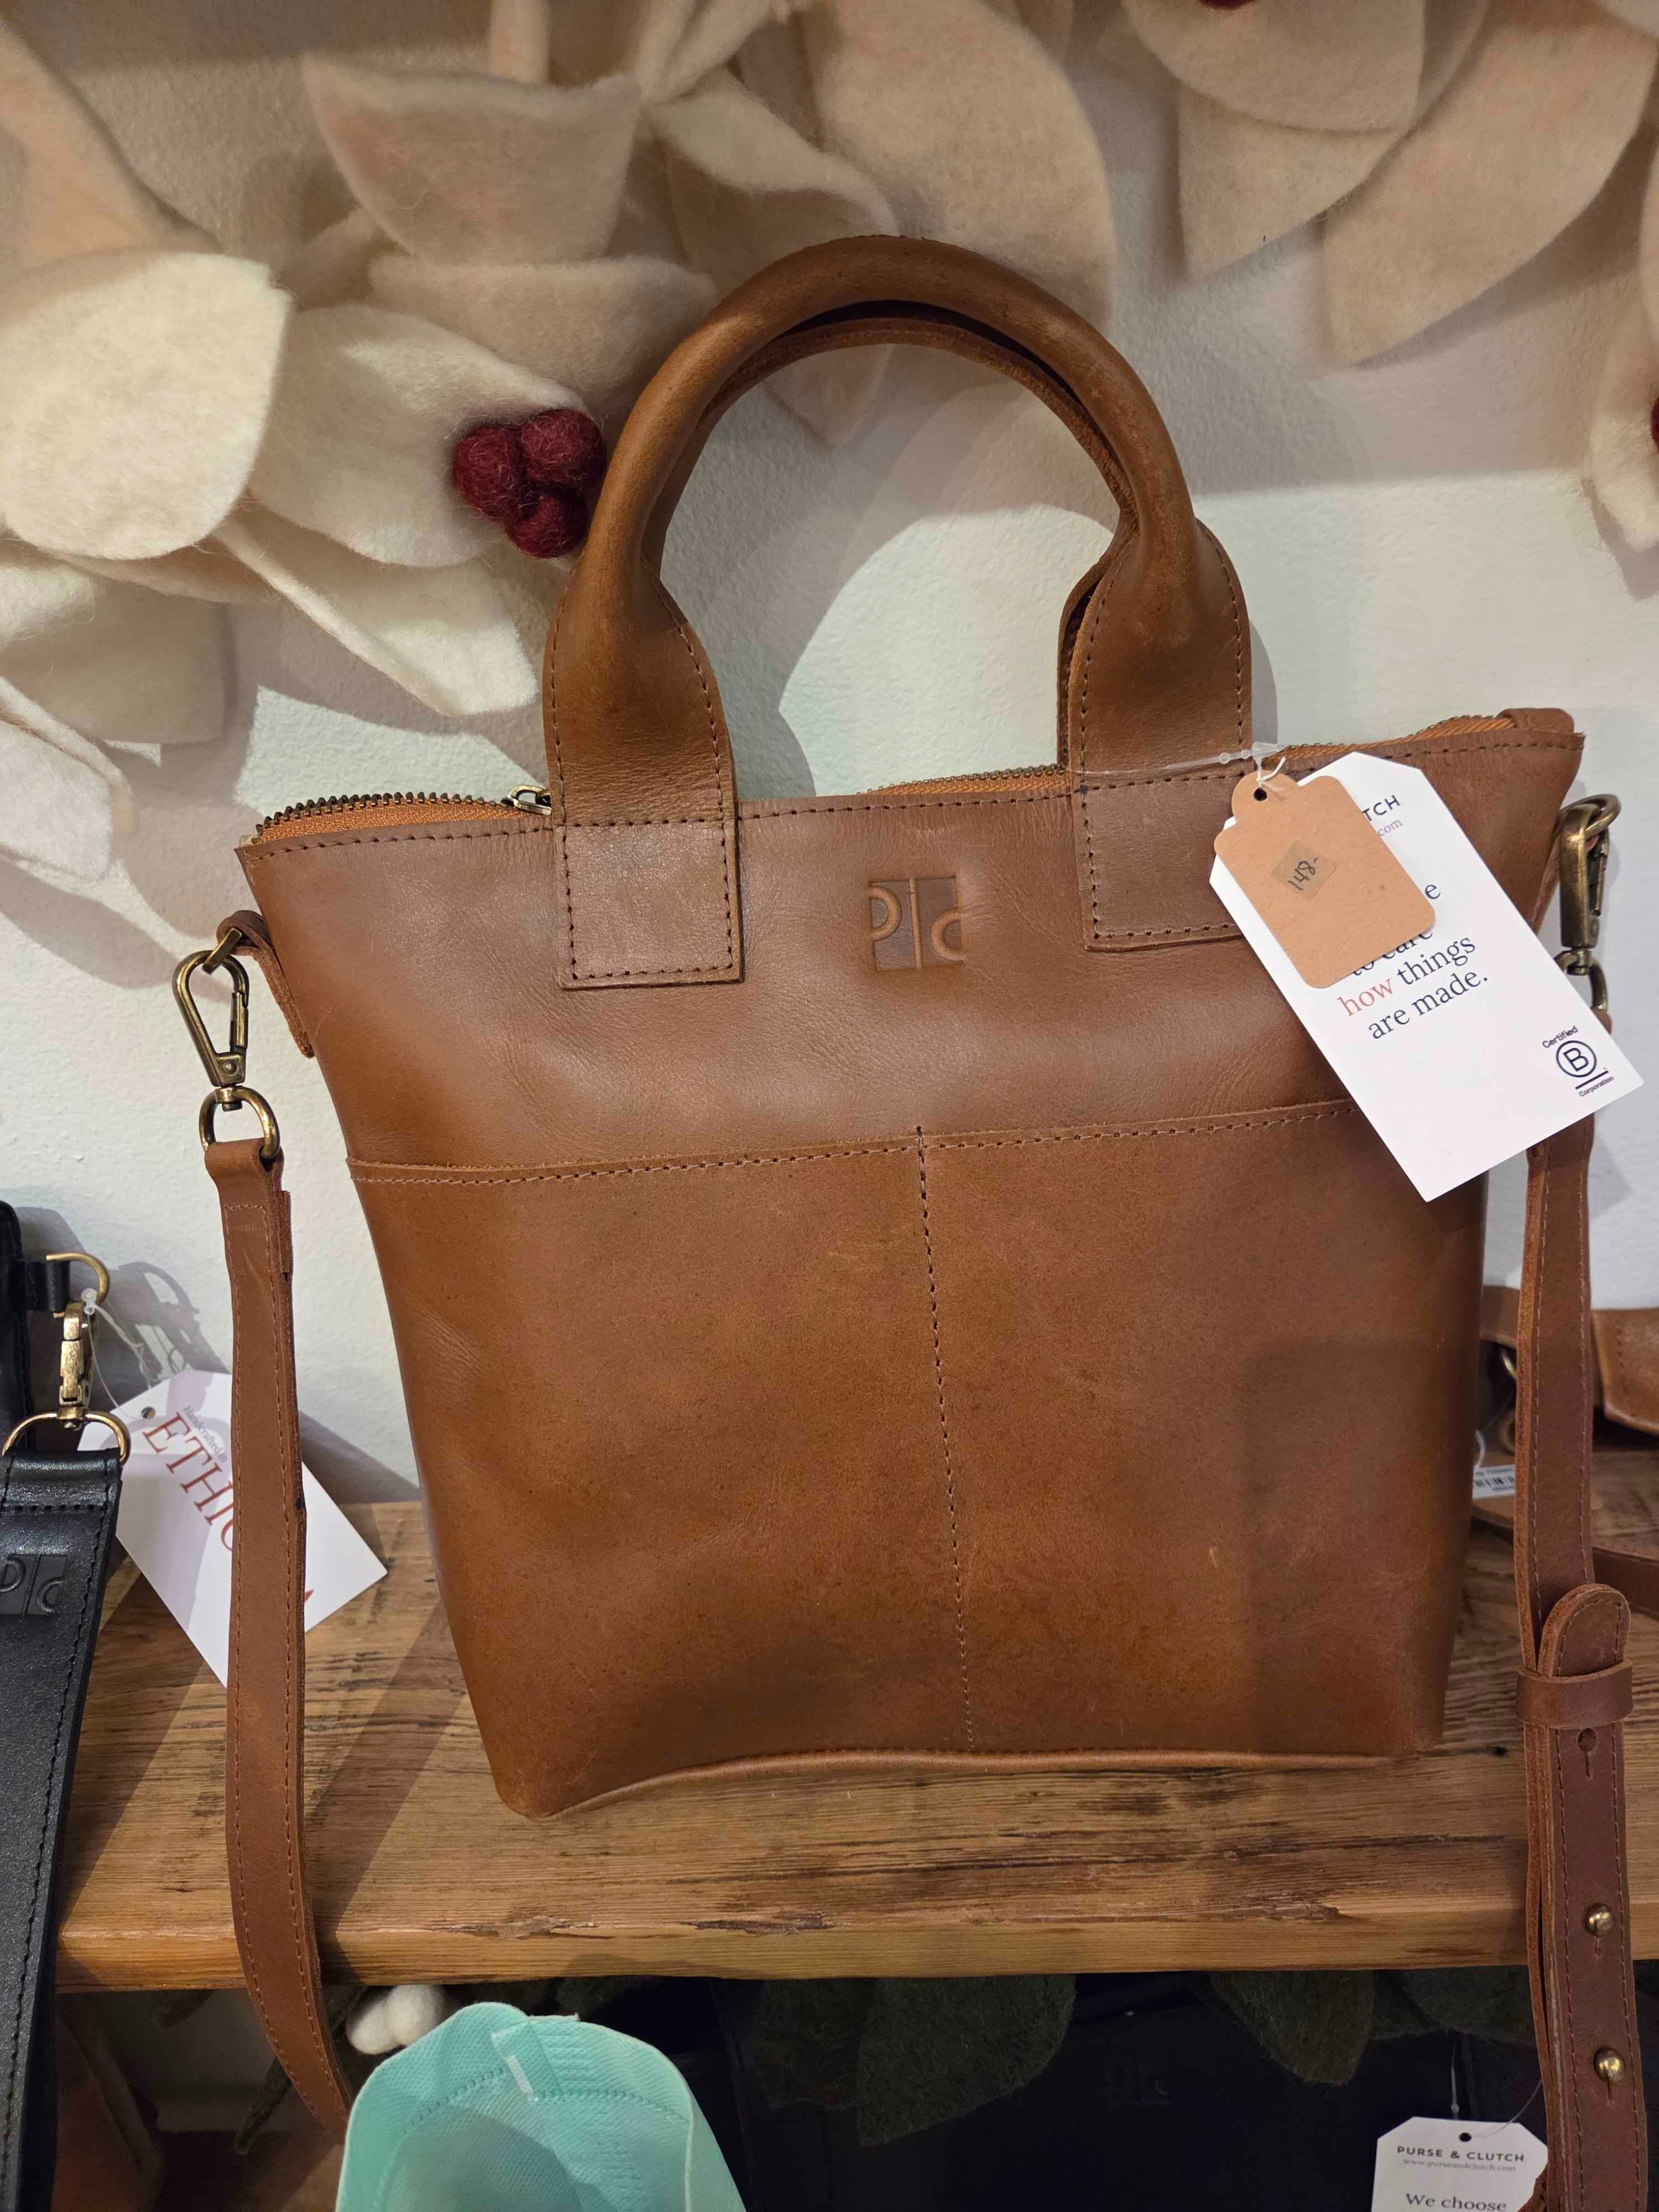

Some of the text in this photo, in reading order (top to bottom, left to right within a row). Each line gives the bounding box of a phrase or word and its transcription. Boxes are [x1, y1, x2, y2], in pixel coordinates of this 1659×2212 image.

[1361, 794, 1401, 822] TCH
[1336, 937, 1475, 1017] how things
[1368, 971, 1488, 1039] are made.
[1542, 1025, 1579, 1048] Certified
[1579, 1076, 1614, 1097] Corporation
[1397, 2146, 1525, 2162] PURSE & CLUTCH
[1406, 2193, 1507, 2211] We choose
